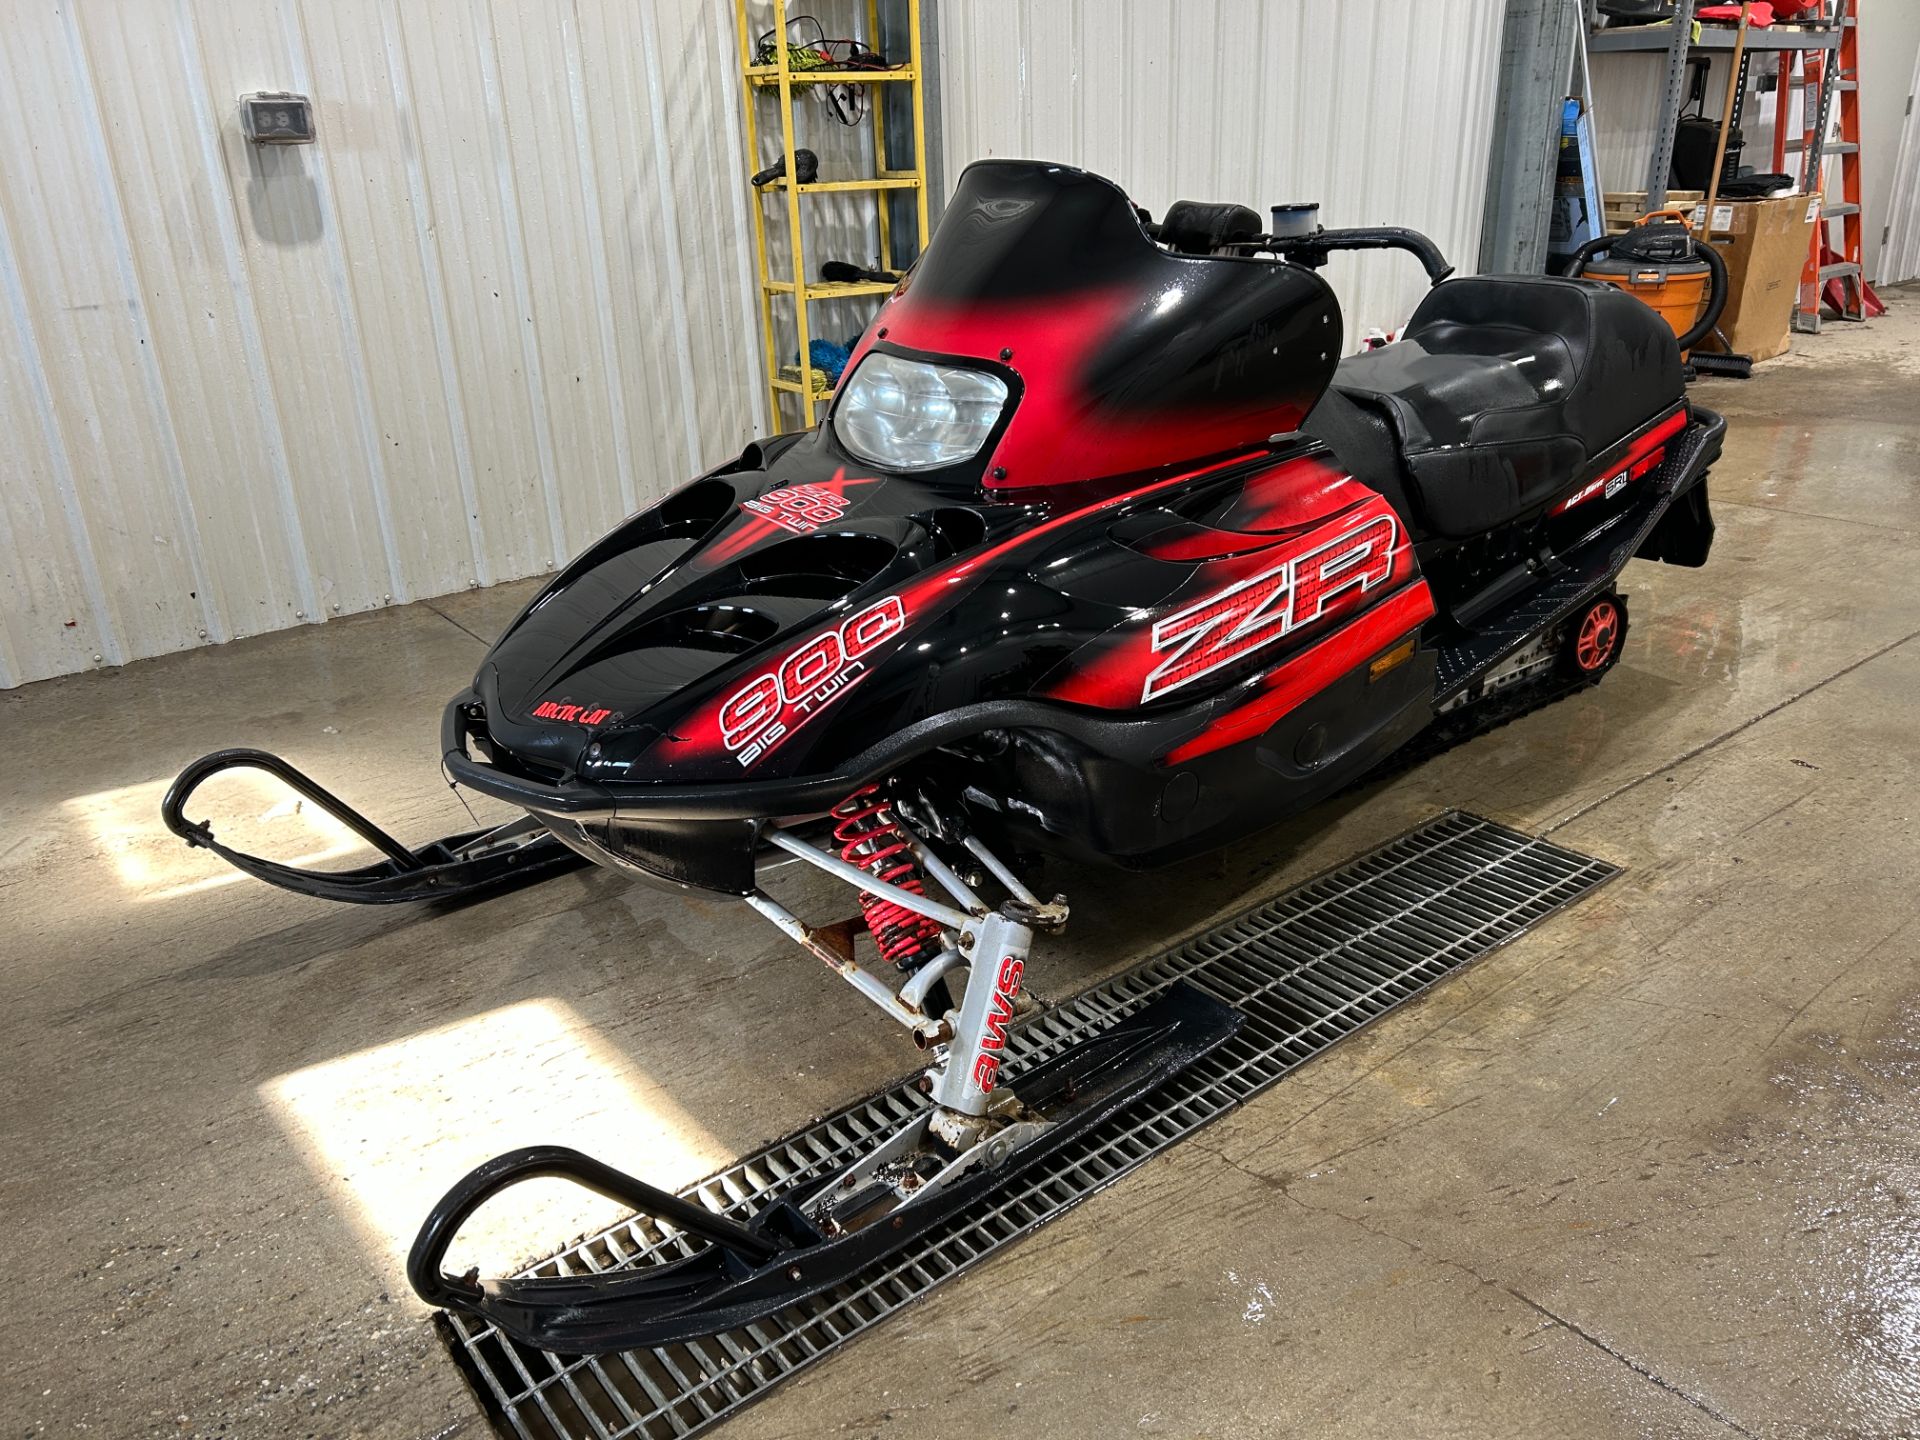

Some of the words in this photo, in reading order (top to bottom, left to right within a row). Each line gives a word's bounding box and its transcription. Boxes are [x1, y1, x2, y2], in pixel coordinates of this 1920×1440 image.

[743, 500, 775, 514] BIG
[778, 511, 820, 531] TWIN
[760, 489, 844, 523] 900
[1141, 514, 1397, 704] ZR
[719, 595, 905, 750] 900
[532, 701, 583, 722] ARCTIC
[579, 709, 612, 725] CAT
[736, 721, 787, 767] BIG
[793, 661, 865, 712] TWIN
